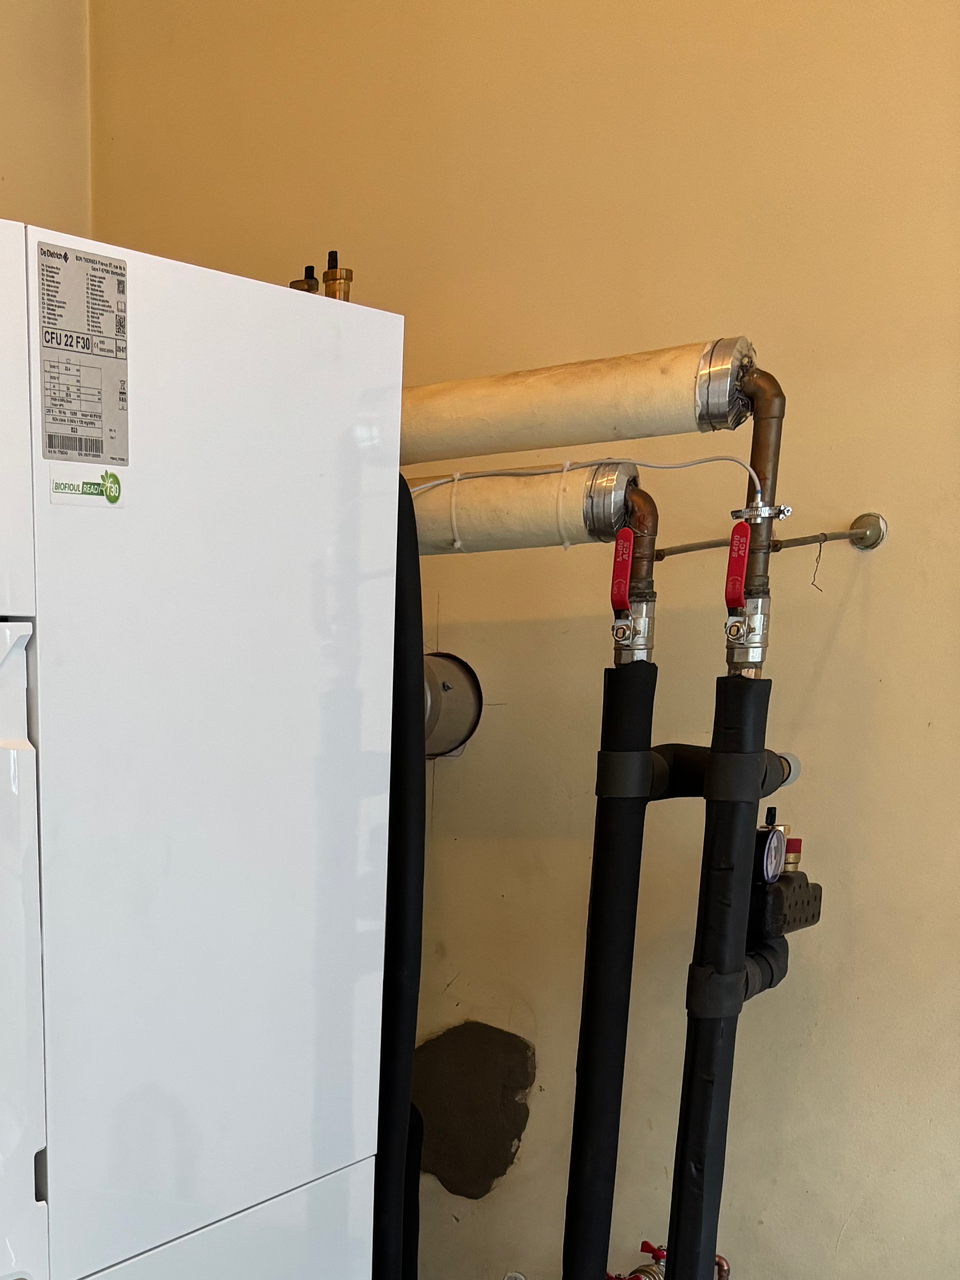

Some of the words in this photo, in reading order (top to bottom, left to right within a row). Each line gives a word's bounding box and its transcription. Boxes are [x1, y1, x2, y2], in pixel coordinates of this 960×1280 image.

[44, 330, 62, 346] CFU
[64, 333, 74, 348] 22
[75, 337, 90, 351] F30
[54, 482, 81, 492] BIOFIOUL
[83, 484, 101, 494] READY
[732, 535, 740, 558] S400
